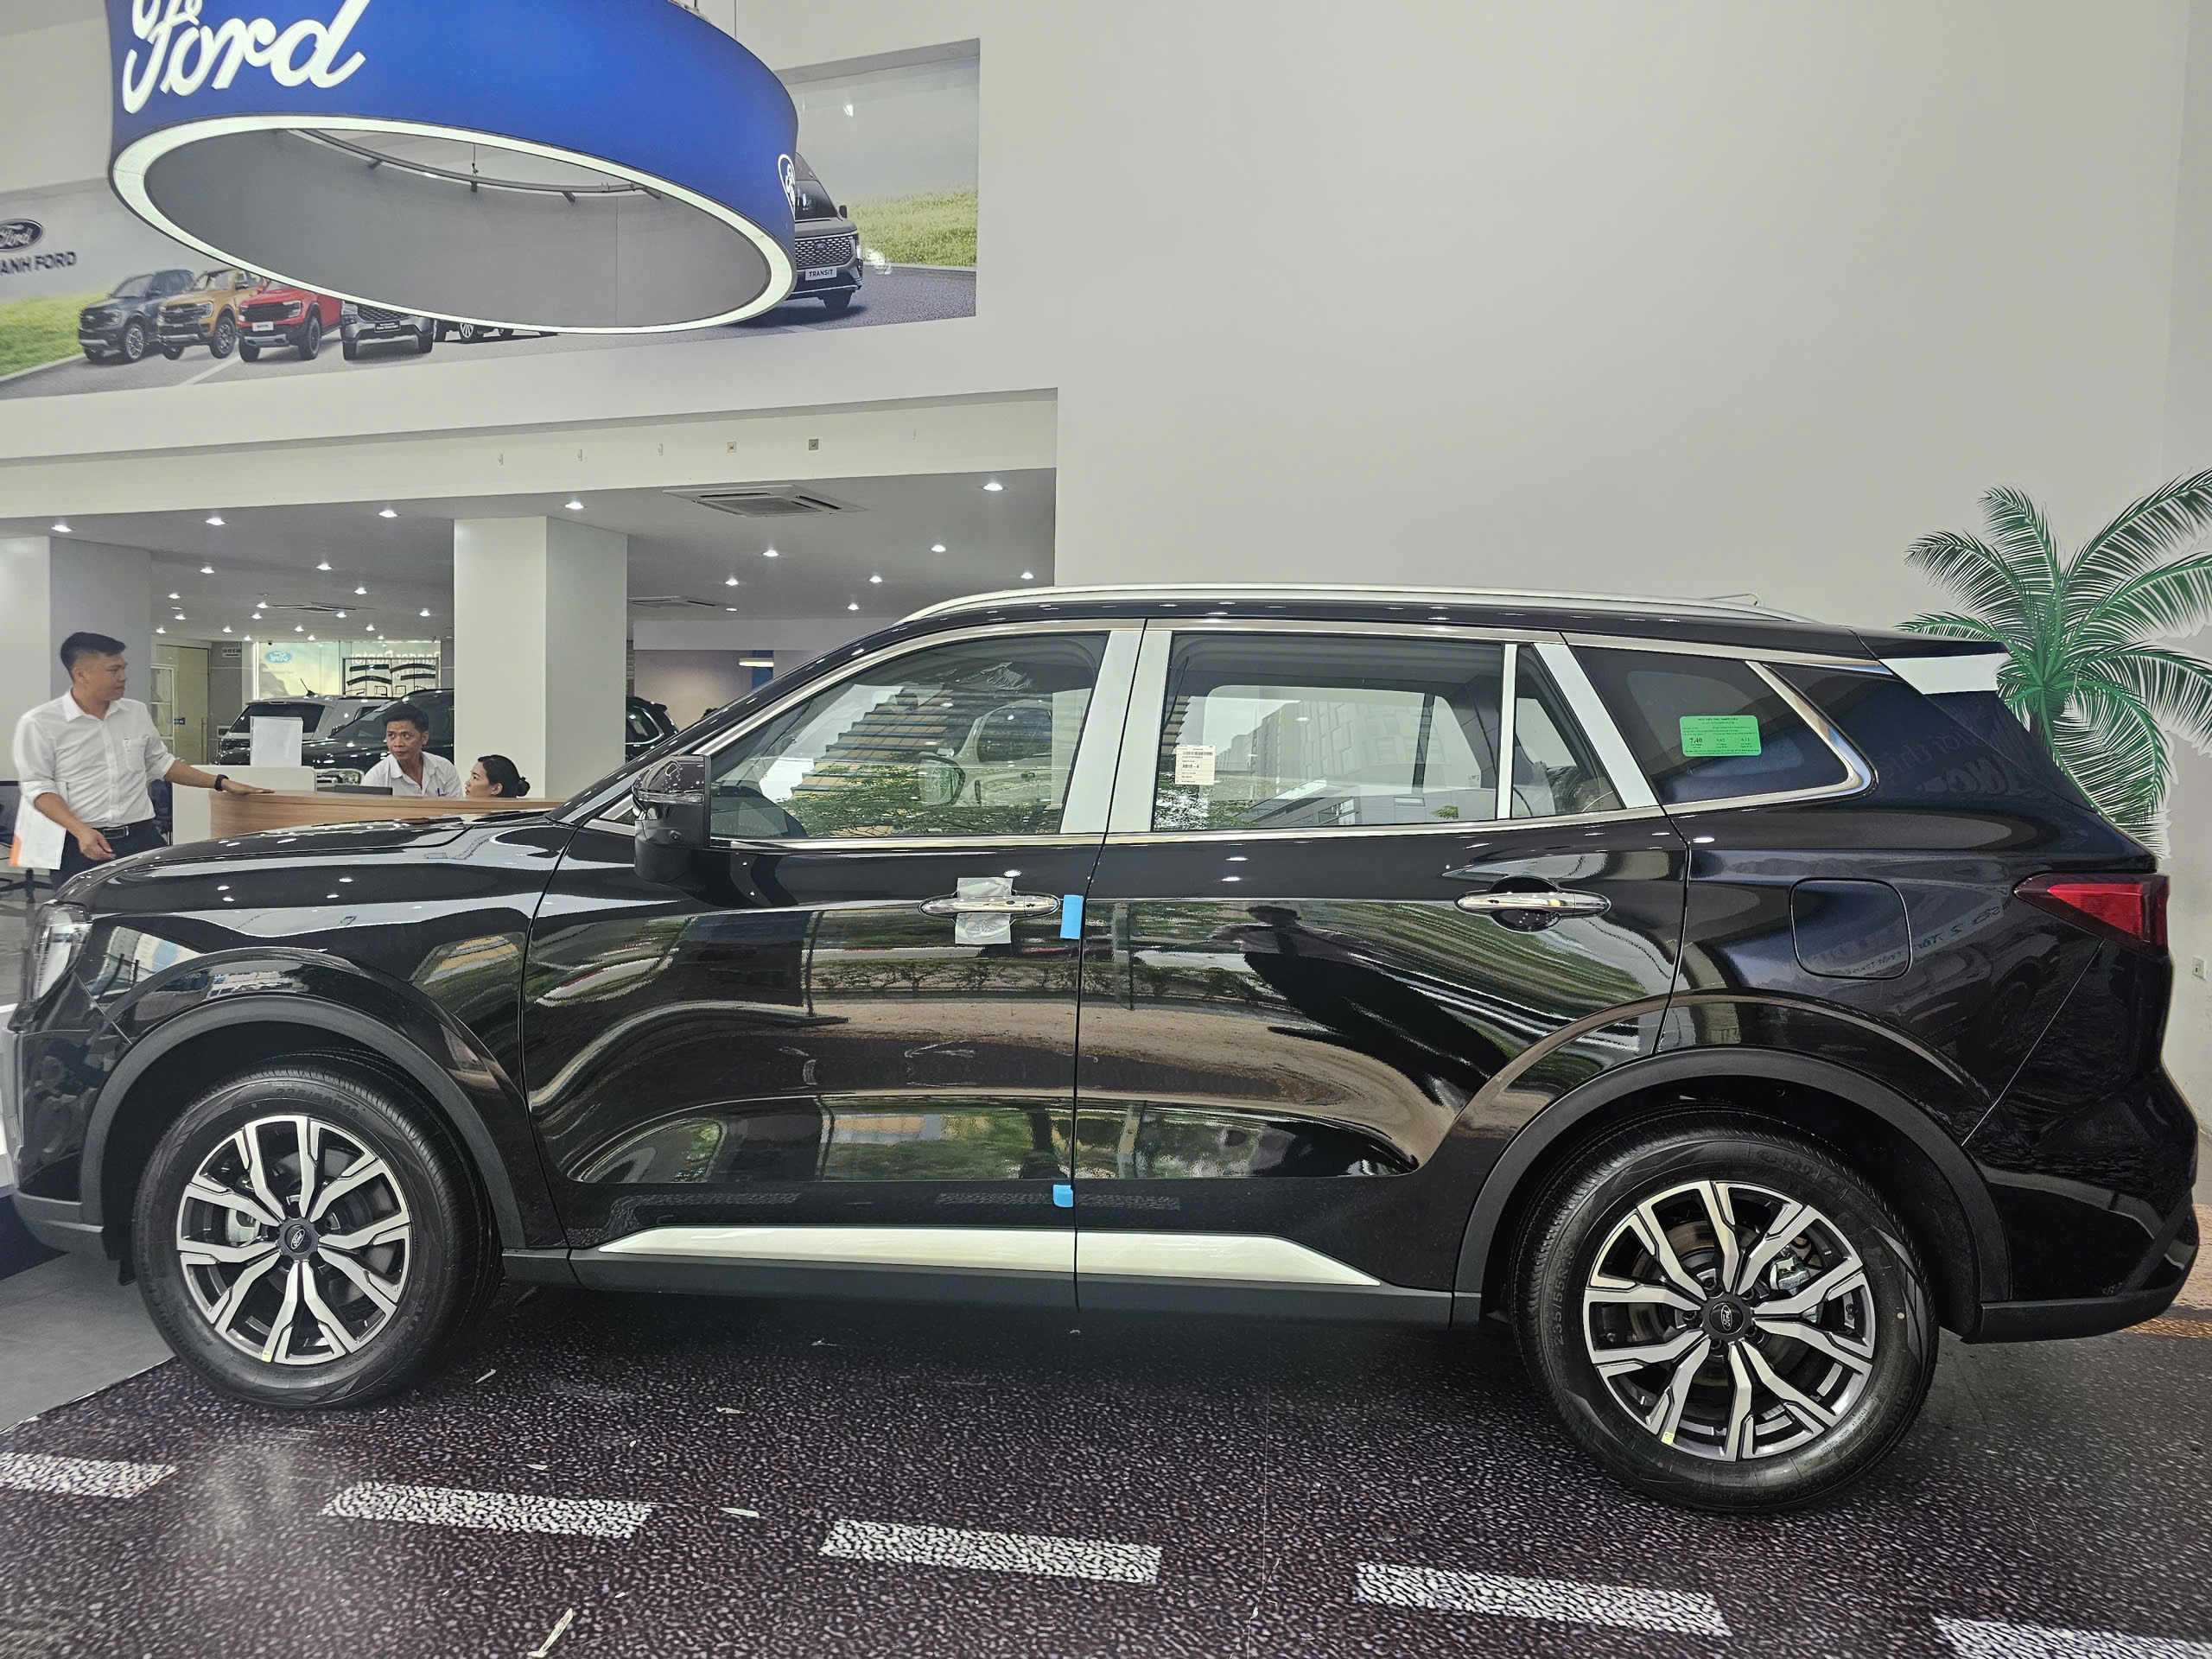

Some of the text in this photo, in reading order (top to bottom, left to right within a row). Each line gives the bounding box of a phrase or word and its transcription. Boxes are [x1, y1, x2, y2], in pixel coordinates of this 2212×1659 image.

[123, 0, 370, 113] Ford
[35, 251, 76, 270] FORD
[809, 269, 834, 277] TRANSIT
